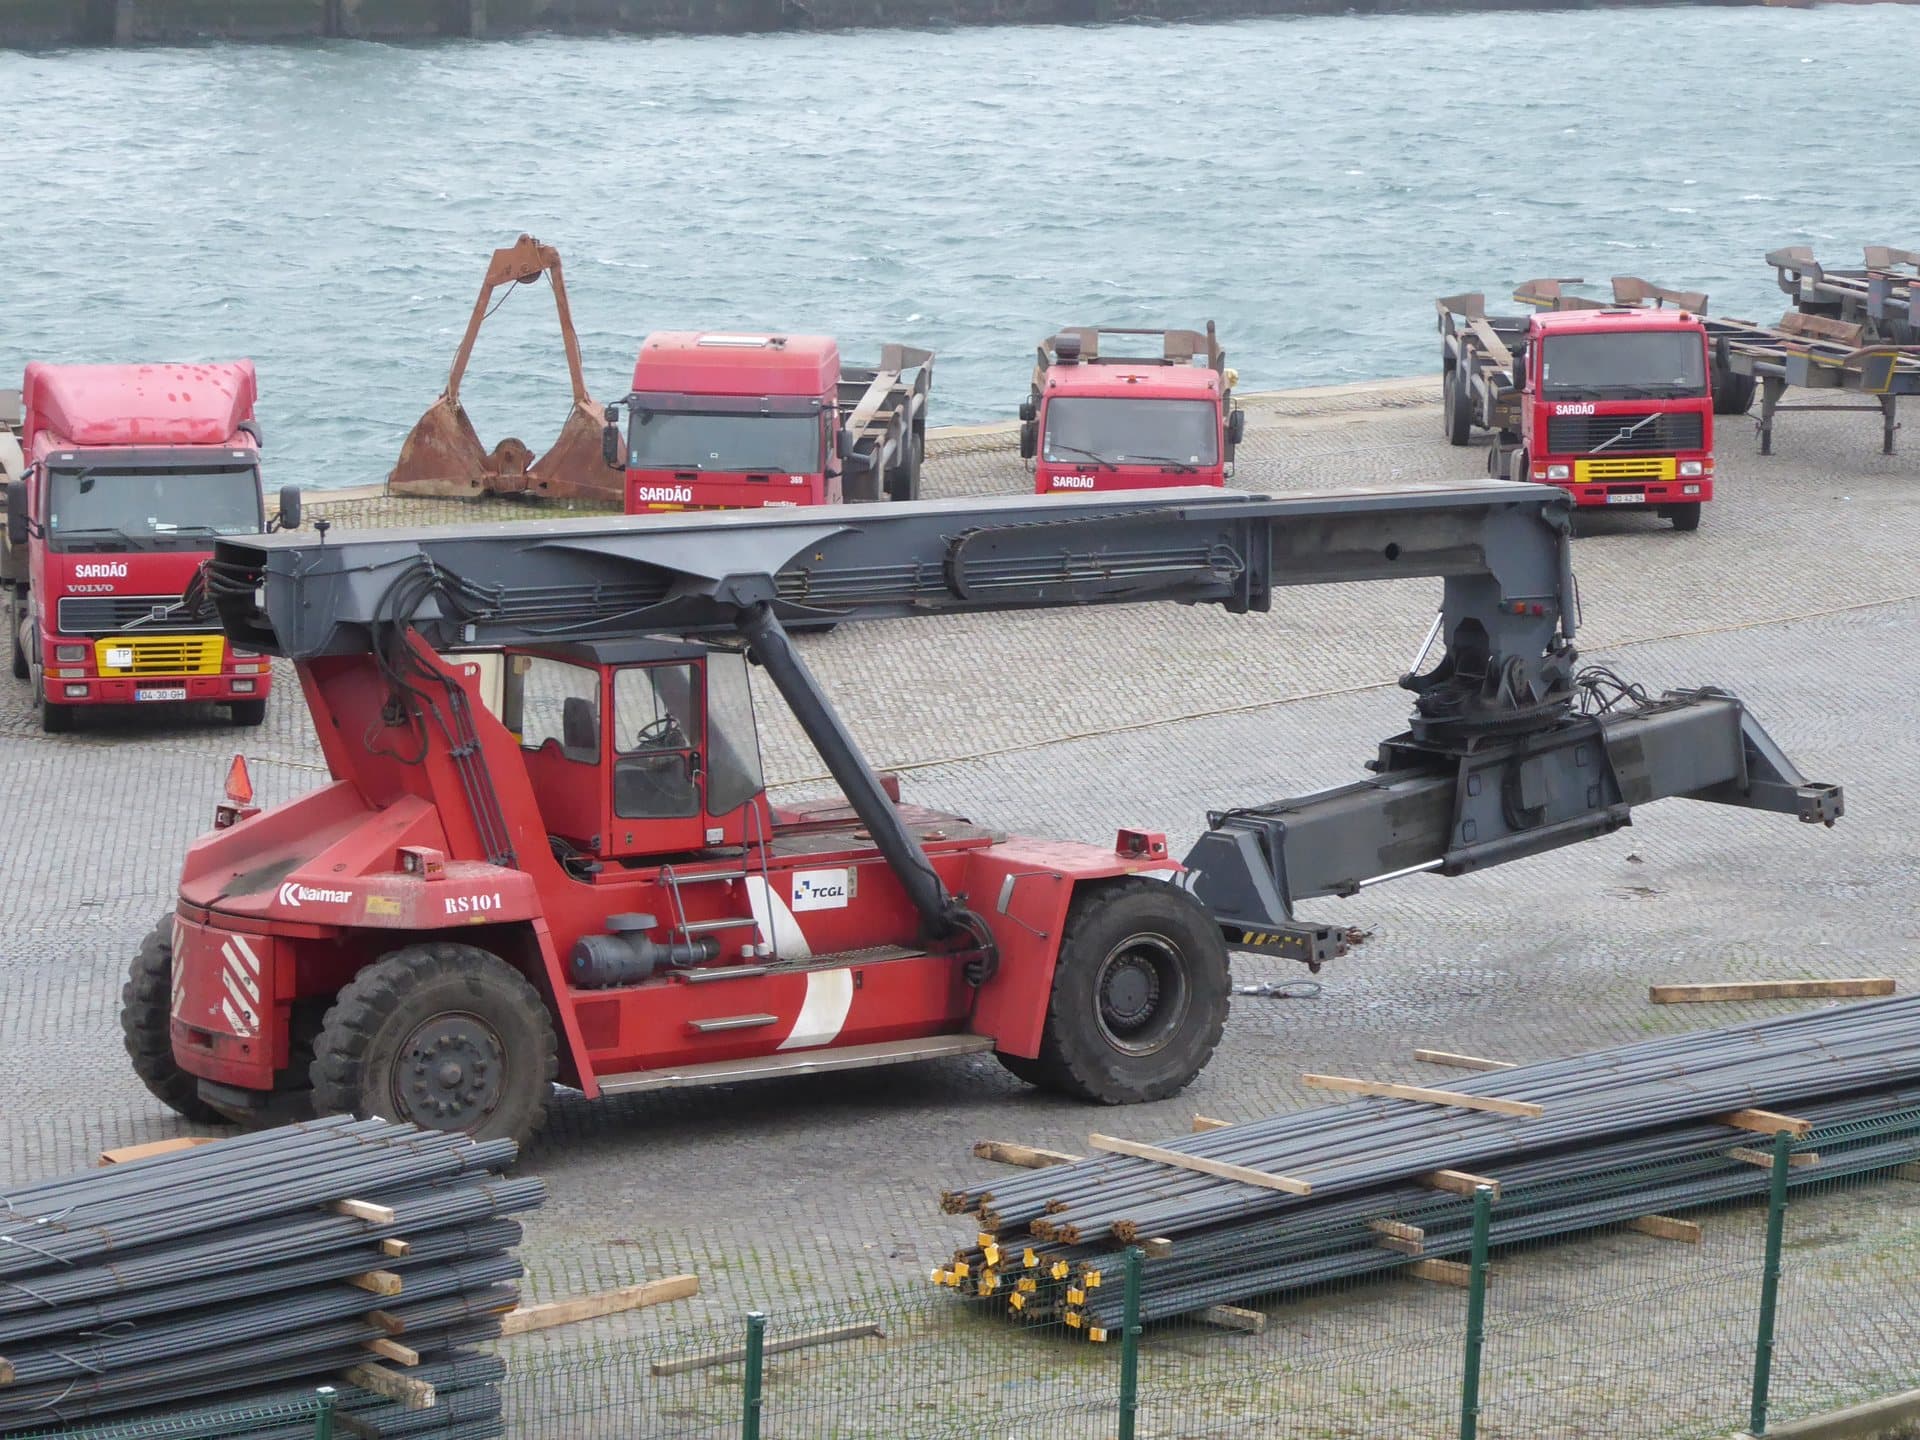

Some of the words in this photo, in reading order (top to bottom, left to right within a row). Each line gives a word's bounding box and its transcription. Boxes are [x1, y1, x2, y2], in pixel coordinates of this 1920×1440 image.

[1556, 402, 1595, 415] SARDÃO
[1053, 475, 1094, 488] SARDÃO
[640, 485, 691, 502] SARDÃO
[75, 561, 127, 578] SARDÃO
[67, 584, 114, 592] VOLVO
[812, 886, 845, 898] TCGL
[444, 893, 502, 913] RS101
